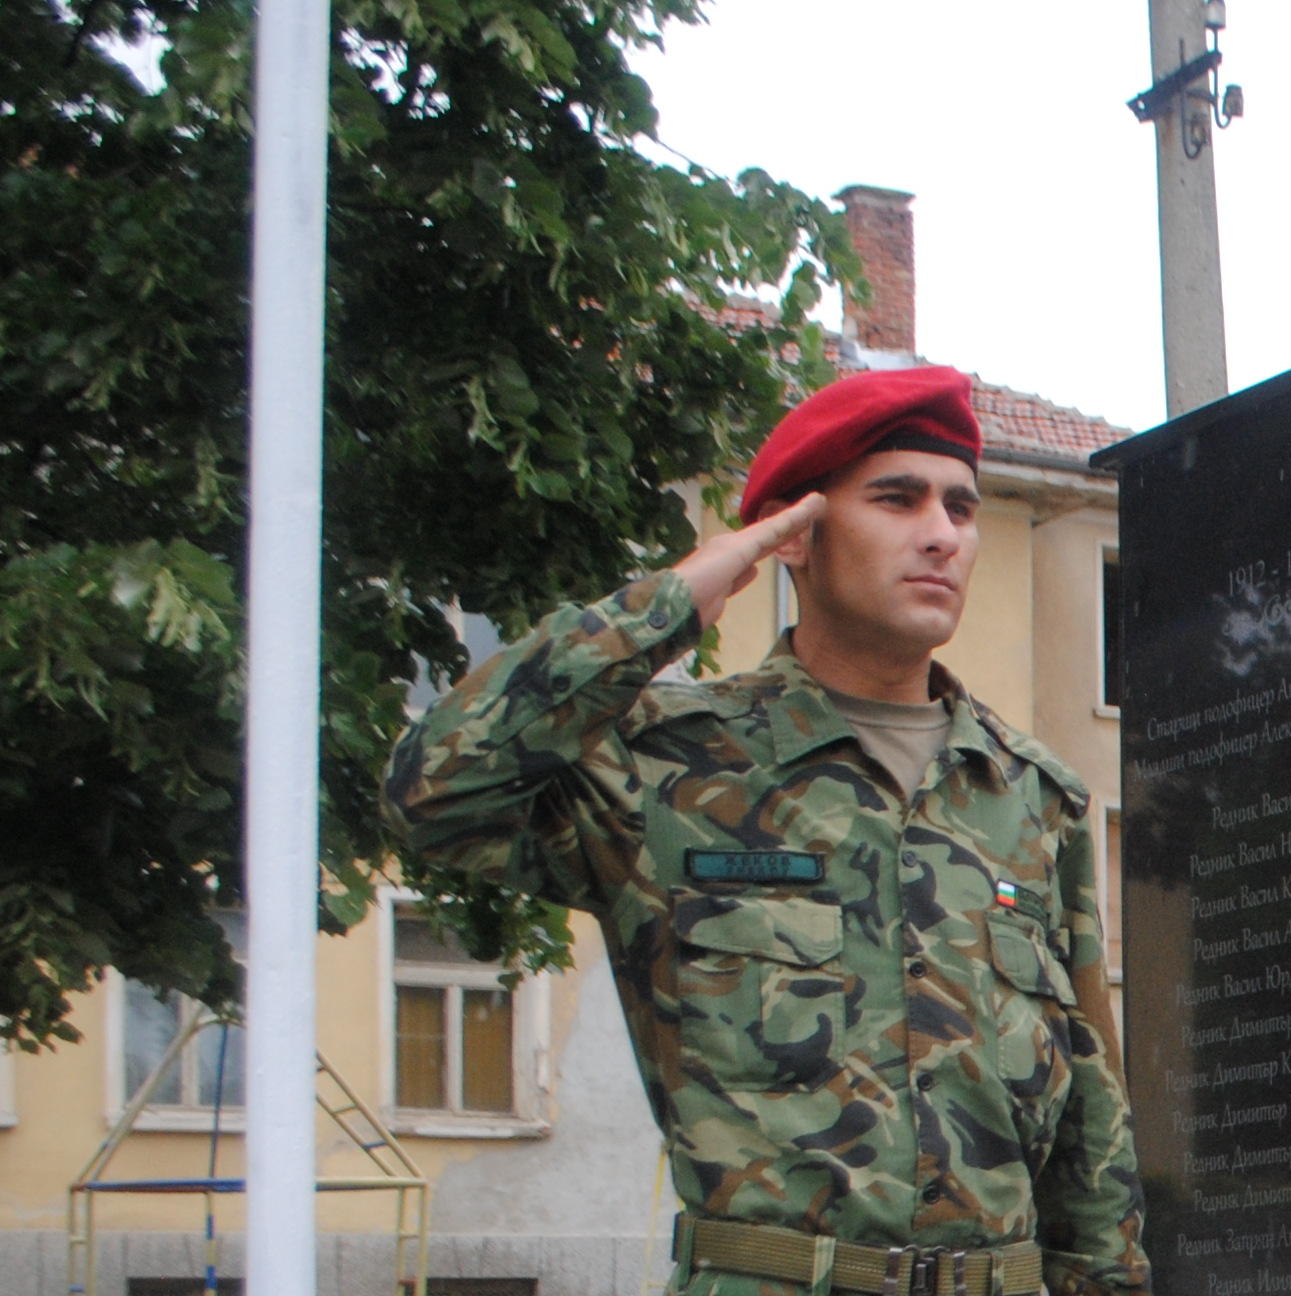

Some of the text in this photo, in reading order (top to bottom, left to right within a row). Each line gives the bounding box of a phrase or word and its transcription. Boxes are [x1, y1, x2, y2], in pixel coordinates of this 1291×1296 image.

[1227, 559, 1267, 597] 1912
[1204, 686, 1274, 724] подофицер
[1187, 728, 1257, 766] подофицер
[1212, 801, 1258, 830] Редник
[1189, 849, 1235, 878] Редник
[1238, 840, 1276, 867] Васил
[1190, 892, 1236, 920] Редник
[1240, 883, 1278, 909] Васил
[1193, 935, 1239, 963] Редник
[1242, 926, 1280, 952] Васил
[1176, 981, 1220, 1008] Редник
[1223, 972, 1262, 998] Васил
[1181, 1022, 1226, 1049] Редник
[1165, 1067, 1209, 1094] Редник
[1212, 1057, 1277, 1089] Димитър
[1173, 1108, 1218, 1135] Редник
[1220, 1101, 1287, 1132] Димитър
[1183, 1149, 1228, 1176] Редник
[1193, 1188, 1239, 1215] Редник
[1177, 1231, 1221, 1259] Редник
[1257, 1267, 1291, 1293] Илия
